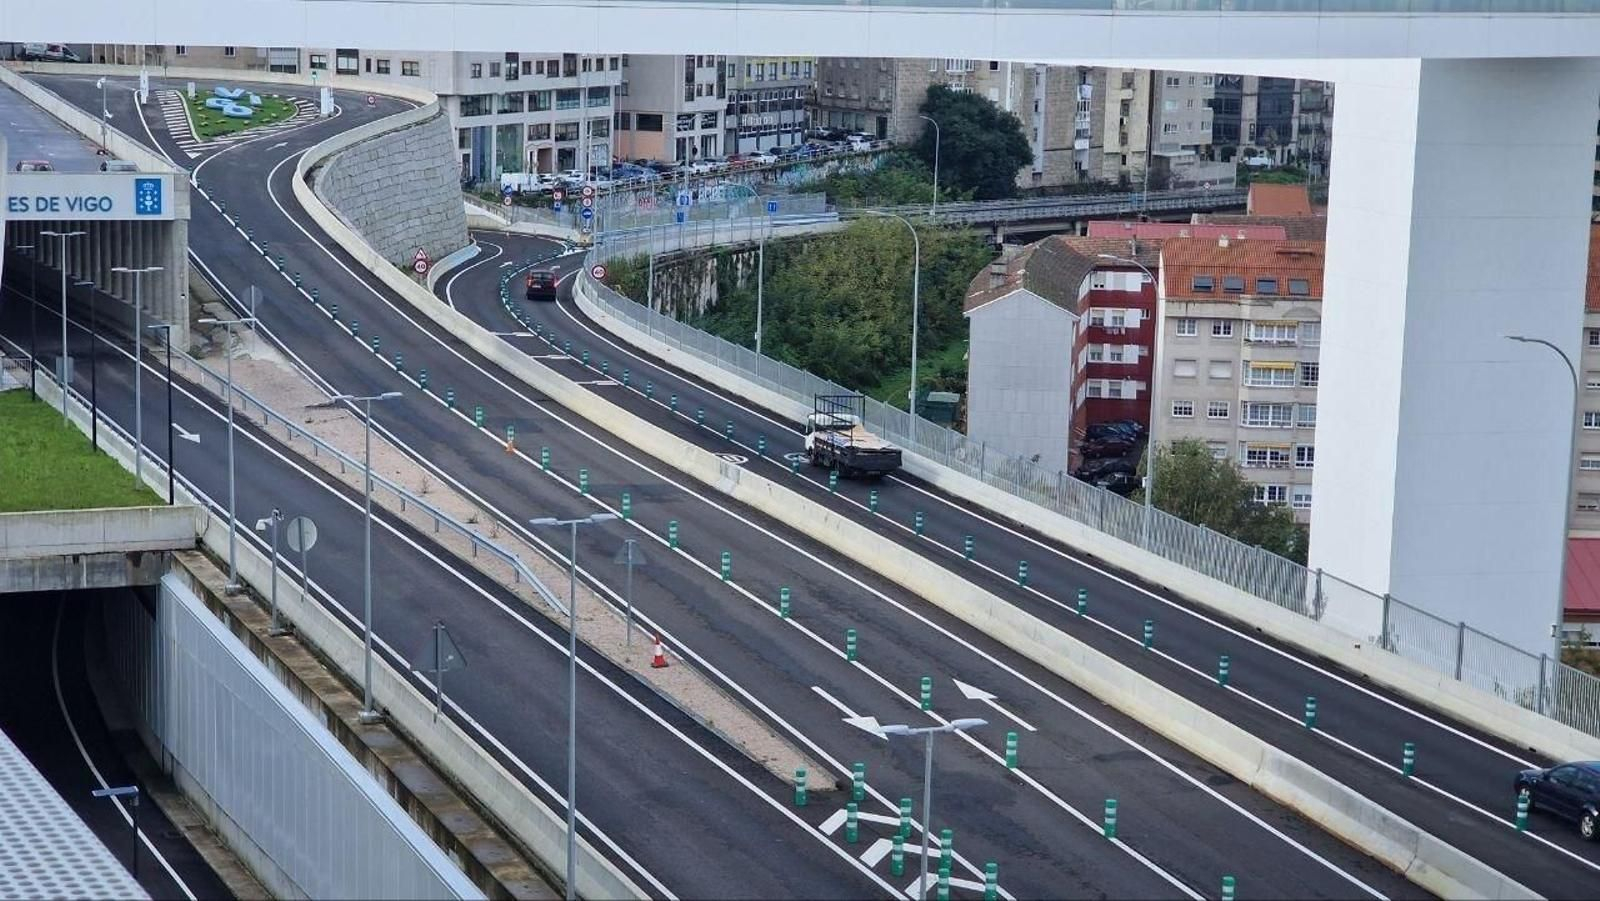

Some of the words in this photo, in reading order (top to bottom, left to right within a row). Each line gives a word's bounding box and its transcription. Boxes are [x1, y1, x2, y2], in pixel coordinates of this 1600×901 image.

[8, 196, 30, 212] ES
[36, 196, 60, 212] DE
[66, 196, 113, 212] VIGO
